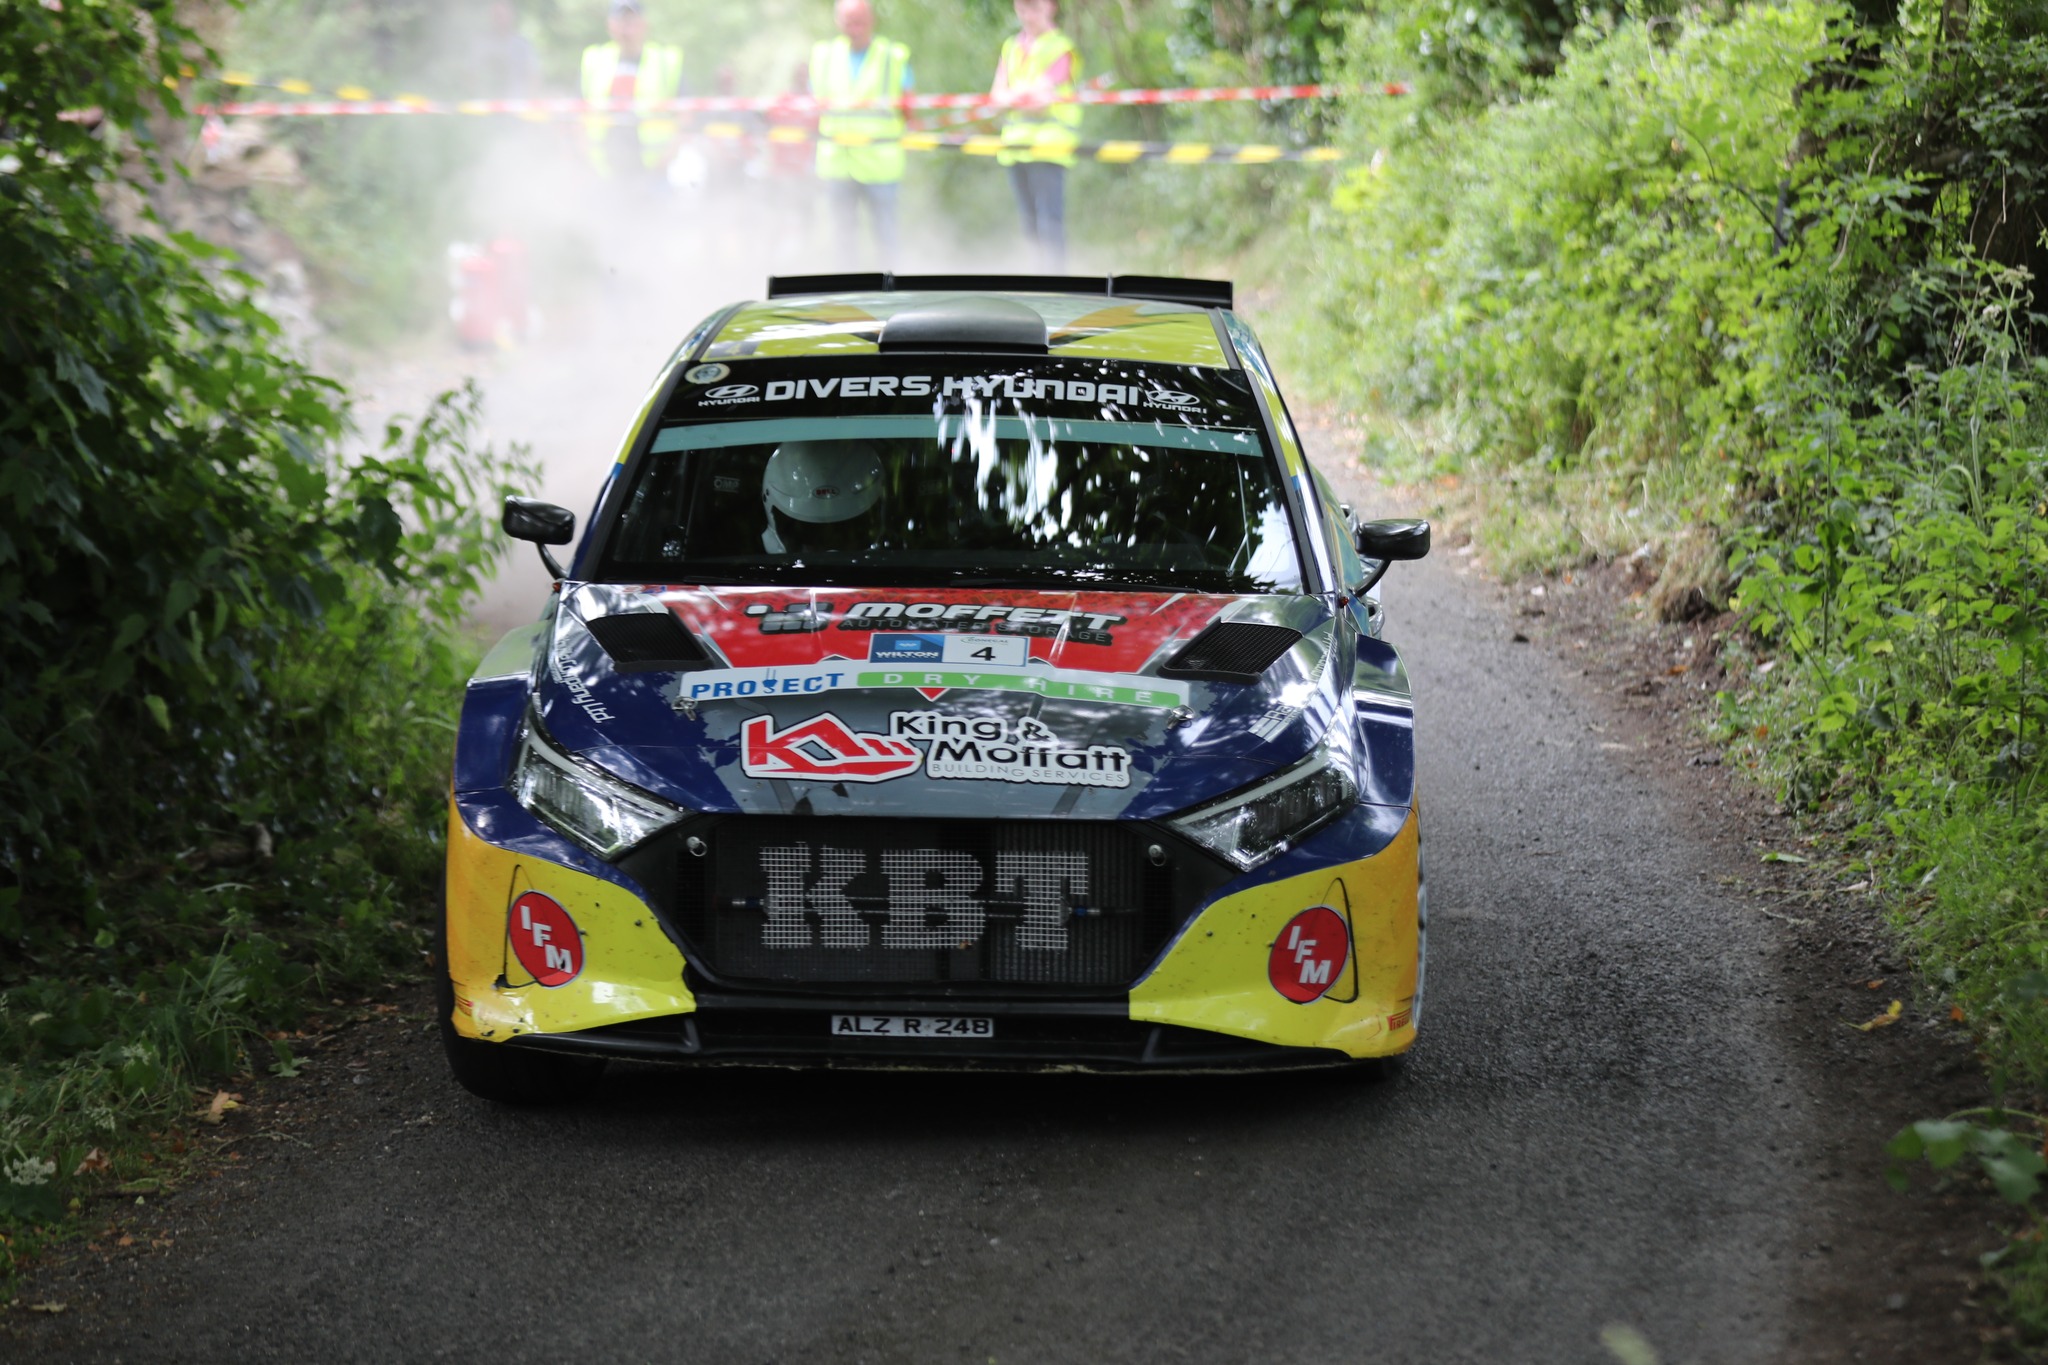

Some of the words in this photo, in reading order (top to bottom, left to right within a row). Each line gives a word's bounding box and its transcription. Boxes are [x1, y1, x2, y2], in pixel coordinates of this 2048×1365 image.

[698, 396, 760, 407] HYUNDAI
[765, 376, 932, 401] DIVERS
[943, 376, 1139, 405] HYUNDAI
[1143, 401, 1208, 414] HYUNDAI
[848, 602, 1122, 630] MOFFETT
[841, 619, 986, 631] AUTOMATED
[998, 622, 1106, 641] STORAGE
[970, 646, 996, 662] 4
[884, 673, 981, 686] DRY
[1027, 677, 1152, 703] HIRE
[897, 715, 1001, 742] King
[1022, 721, 1050, 741] &
[934, 741, 1125, 772] Moffatt
[932, 763, 1025, 777] BUILDING
[1032, 769, 1125, 783] SERVICES
[759, 842, 1089, 950] KBT
[520, 905, 573, 974] IFM
[1287, 925, 1332, 984] IFM
[838, 1016, 891, 1033] ALZ
[903, 1018, 922, 1034] R
[935, 1018, 990, 1035] 248
